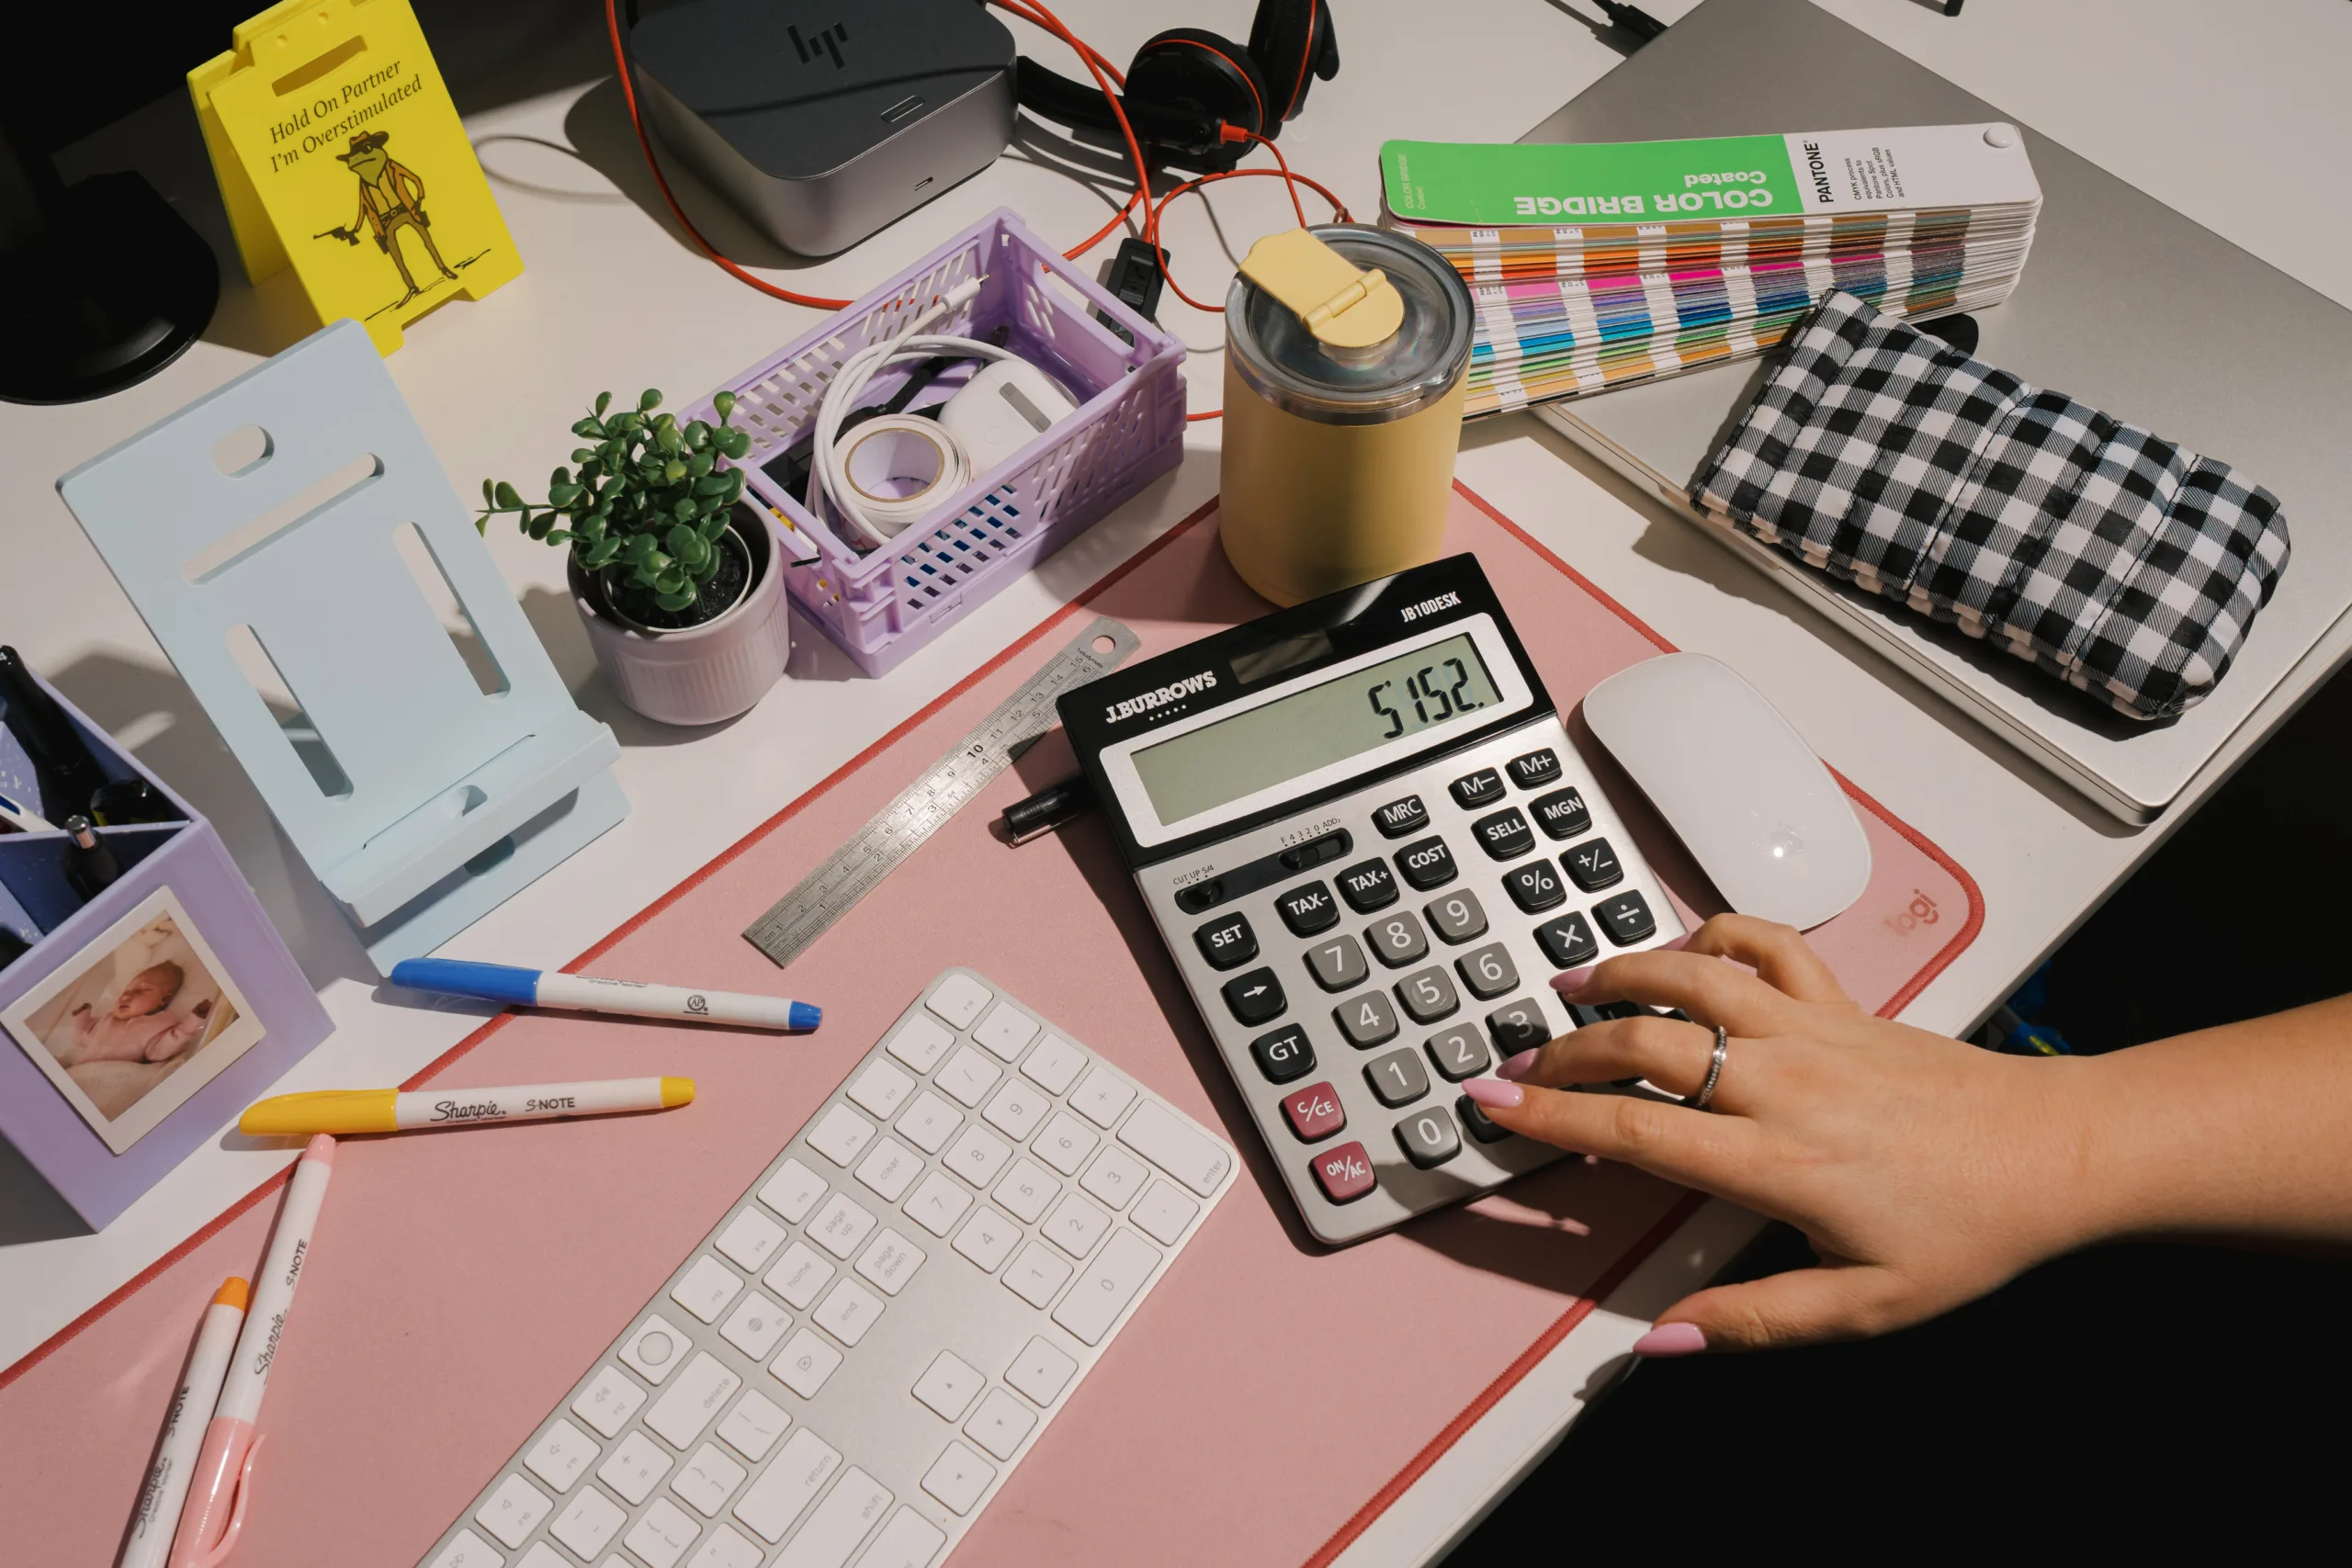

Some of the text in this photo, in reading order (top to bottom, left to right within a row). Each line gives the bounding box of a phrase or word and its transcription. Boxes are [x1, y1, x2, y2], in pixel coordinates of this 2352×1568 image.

[270, 61, 401, 144] Hold On Partner
[270, 73, 423, 173] I'm Overstimulated
[1885, 149, 1894, 167] values
[1397, 153, 1414, 209] COLOR BRIDGE
[1684, 171, 1767, 187] Coated
[1845, 157, 1861, 200] CMYK process
[1858, 167, 1872, 199] equivalents
[1866, 160, 1883, 199] Pantone Spot
[1872, 147, 1894, 198] Colors, plus sRGB
[1891, 168, 1901, 186] HTML
[1416, 186, 1426, 209] Coated
[1514, 188, 1773, 215] COLOR BRIDGE
[1400, 591, 1462, 624] JB10DESK
[1104, 671, 1218, 725] J.BURROWS
[873, 853, 883, 863] 2
[927, 805, 937, 813] 3
[1032, 711, 1041, 719] 5
[1082, 665, 1091, 673] 6
[1519, 754, 1553, 775] M+
[1461, 775, 1496, 795] M-
[763, 931, 776, 942] cm
[797, 904, 807, 913] 2
[819, 885, 828, 894] 3
[842, 866, 850, 874] 4
[863, 846, 872, 855] 5
[885, 827, 893, 835] 6
[905, 807, 913, 816] 7
[926, 789, 935, 797] 8
[947, 771, 956, 779] 9
[967, 744, 983, 759] 10
[990, 728, 1003, 740] 11
[1011, 710, 1024, 722] 12
[1031, 692, 1045, 704] 13
[1050, 674, 1064, 685] 14
[1383, 799, 1423, 825] MRC
[1544, 797, 1584, 821] MGN
[1487, 818, 1526, 841] SELL
[1408, 844, 1447, 869] COST
[1173, 864, 1214, 885] CUT UP 5/4
[1347, 869, 1390, 893] TAX+
[1521, 871, 1555, 895] %
[1288, 892, 1329, 917] TAX-
[1446, 899, 1470, 927] 9
[1883, 888, 1939, 936] logi
[1211, 924, 1243, 950] SET
[1391, 921, 1413, 949] 8
[1325, 946, 1346, 974] 7
[1479, 953, 1504, 981] 6
[963, 998, 975, 1011] F19
[1418, 979, 1441, 1005] 5
[1359, 1003, 1381, 1029] 4
[1509, 1010, 1533, 1039] 3
[1268, 1036, 1302, 1062] GT
[1449, 1036, 1475, 1063] 2
[1388, 1061, 1410, 1087] 1
[886, 1087, 898, 1100] F17
[1010, 1102, 1023, 1116] 9
[1297, 1095, 1335, 1122] C/CE
[1058, 1135, 1072, 1150] 6
[1418, 1118, 1442, 1146] 0
[971, 1149, 985, 1162] 8
[1326, 1155, 1366, 1182] ON/AC
[879, 1157, 900, 1181] clear
[1107, 1170, 1121, 1184] 3
[1203, 1159, 1223, 1185] enter
[931, 1197, 944, 1210] 7
[1019, 1185, 1034, 1197] 5
[825, 1209, 847, 1234] page
[840, 1222, 854, 1237] up
[1069, 1219, 1083, 1232] 2
[982, 1232, 994, 1246] 4
[874, 1245, 895, 1269] page
[884, 1252, 908, 1278] down
[786, 1261, 812, 1289] home
[1031, 1268, 1044, 1280] 1
[1101, 1278, 1114, 1292] 0
[841, 1301, 858, 1322] end
[703, 1378, 731, 1410] delete
[804, 1455, 832, 1488] return
[862, 1494, 883, 1519] shift
